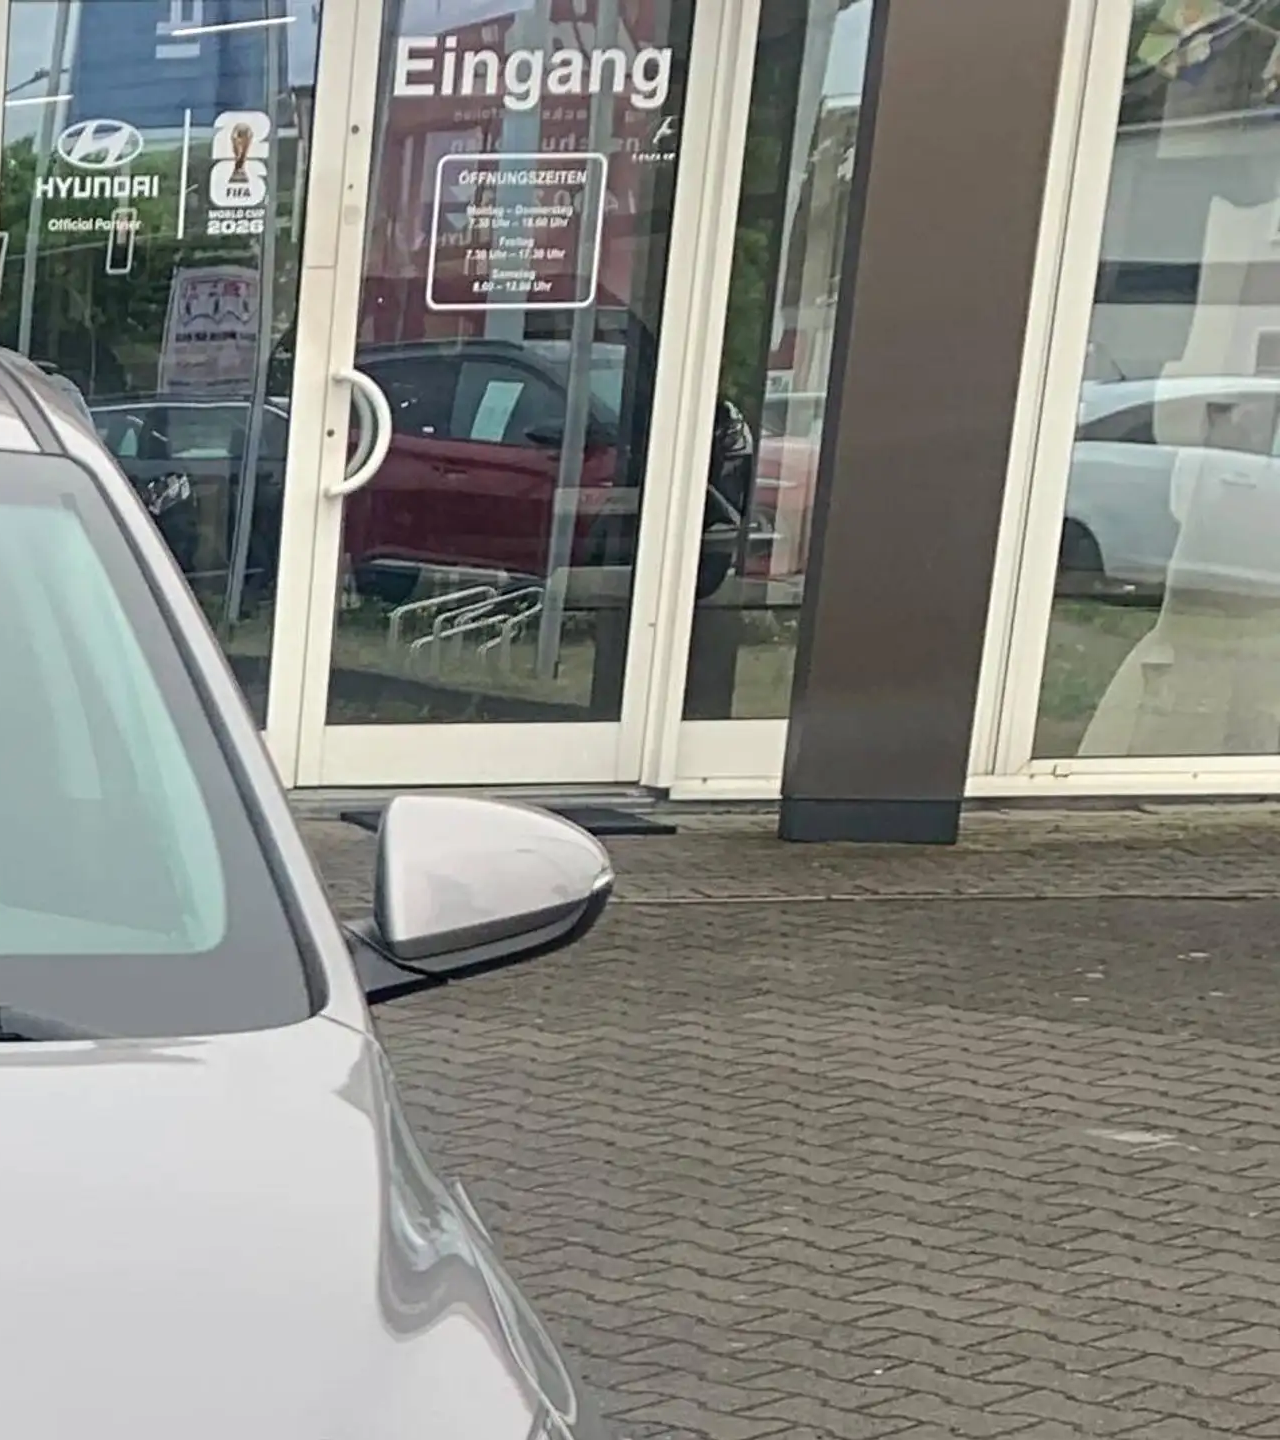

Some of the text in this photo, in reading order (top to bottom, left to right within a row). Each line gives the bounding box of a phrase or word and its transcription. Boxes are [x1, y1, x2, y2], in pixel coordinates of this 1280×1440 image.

[394, 35, 673, 110] Eingang
[458, 168, 588, 185] ÖFFNUNGSZEITEN
[35, 175, 159, 199] HYUNDAI
[226, 187, 251, 198] FIFA
[208, 208, 266, 219] WORLD CUP
[48, 218, 142, 231] Official Partner
[206, 220, 265, 234] 2026
